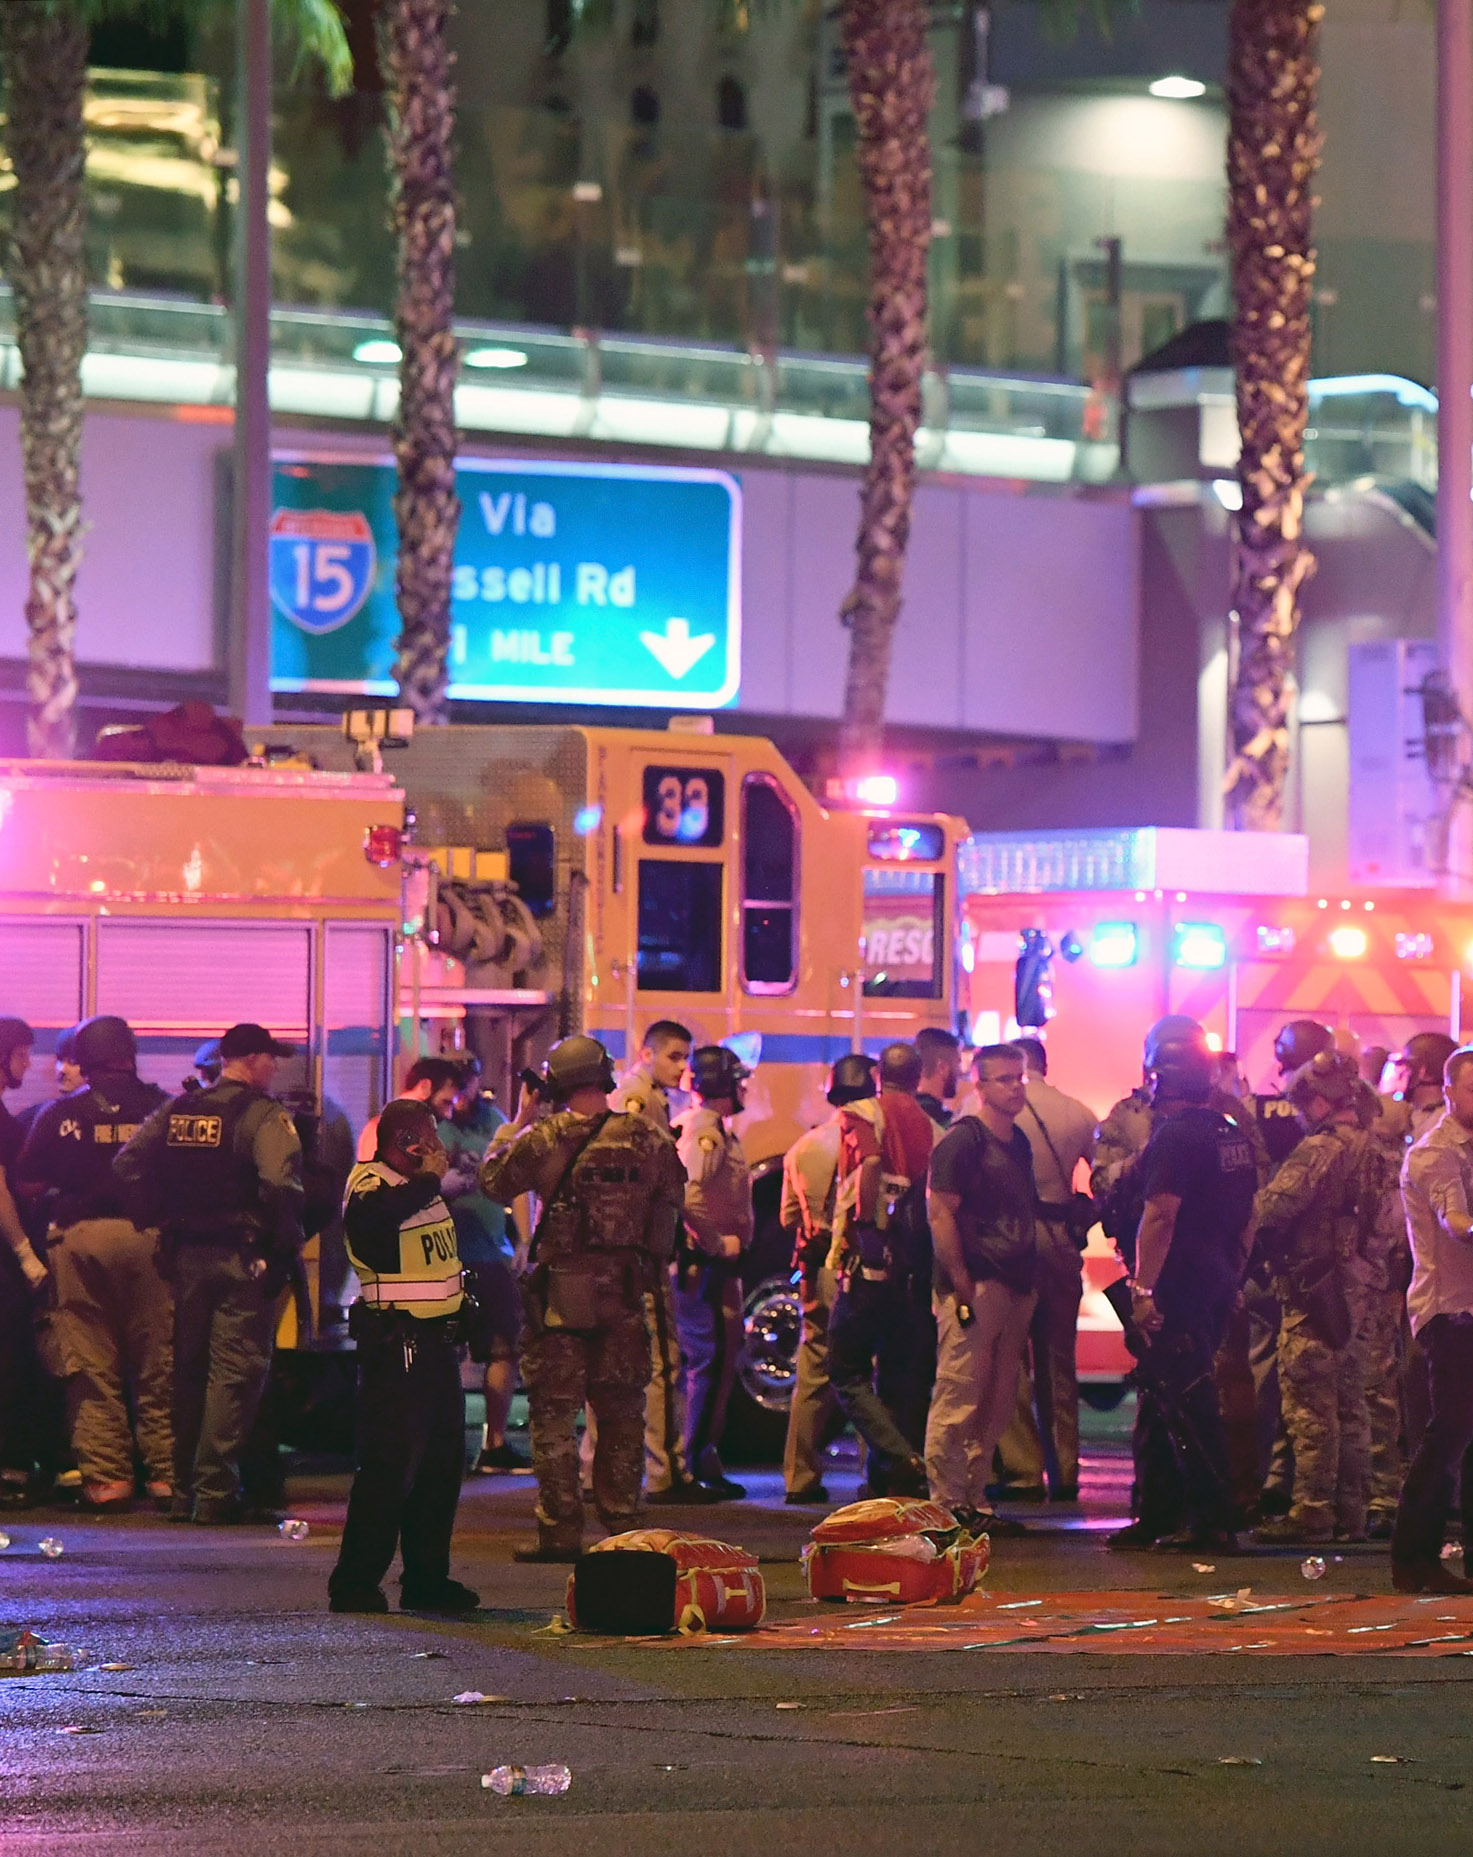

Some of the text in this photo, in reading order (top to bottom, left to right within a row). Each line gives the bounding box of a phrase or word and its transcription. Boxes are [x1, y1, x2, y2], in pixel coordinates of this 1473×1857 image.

[478, 490, 556, 539] Via
[292, 543, 355, 612] 15
[452, 561, 636, 608] ssell Rd
[491, 628, 576, 667] MILE
[656, 776, 709, 838] 33
[867, 928, 934, 965] RESC
[168, 1118, 218, 1144] POLICE
[421, 1226, 457, 1266] POLI
